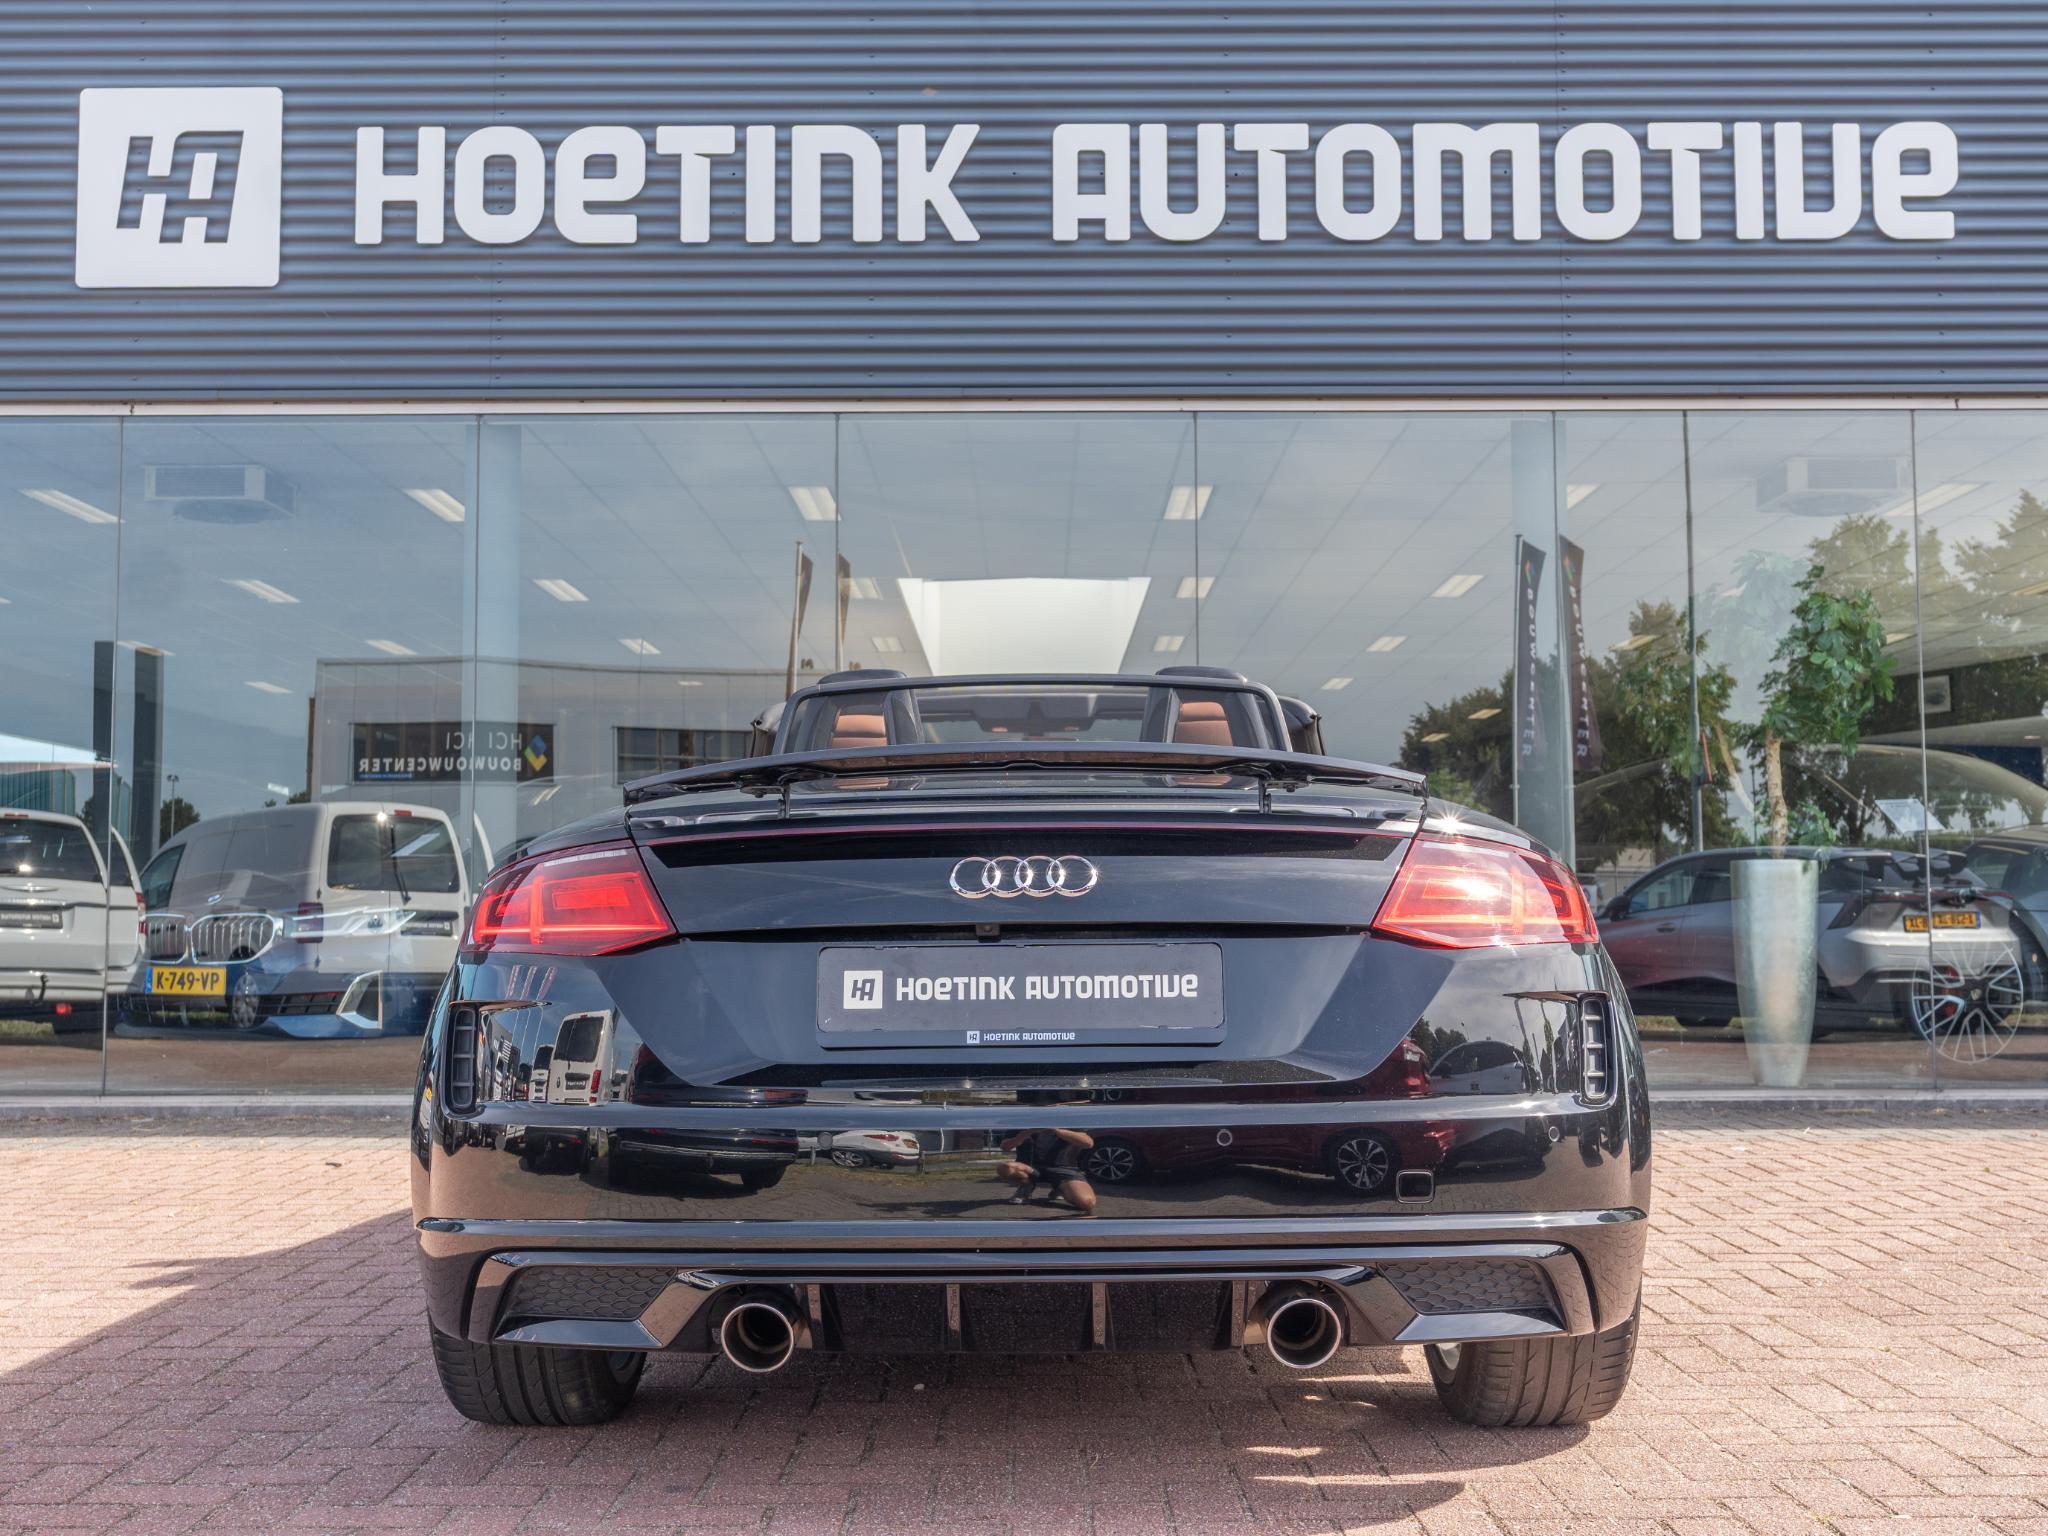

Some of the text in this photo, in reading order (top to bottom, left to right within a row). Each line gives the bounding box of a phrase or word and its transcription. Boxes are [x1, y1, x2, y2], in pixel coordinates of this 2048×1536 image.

[1052, 121, 1959, 242] AUTOMOTIVE
[156, 971, 220, 990] K-749-VP
[1025, 974, 1198, 1000] AUTOMOTIVE
[1022, 1031, 1076, 1041] AUTOMOTIVE
